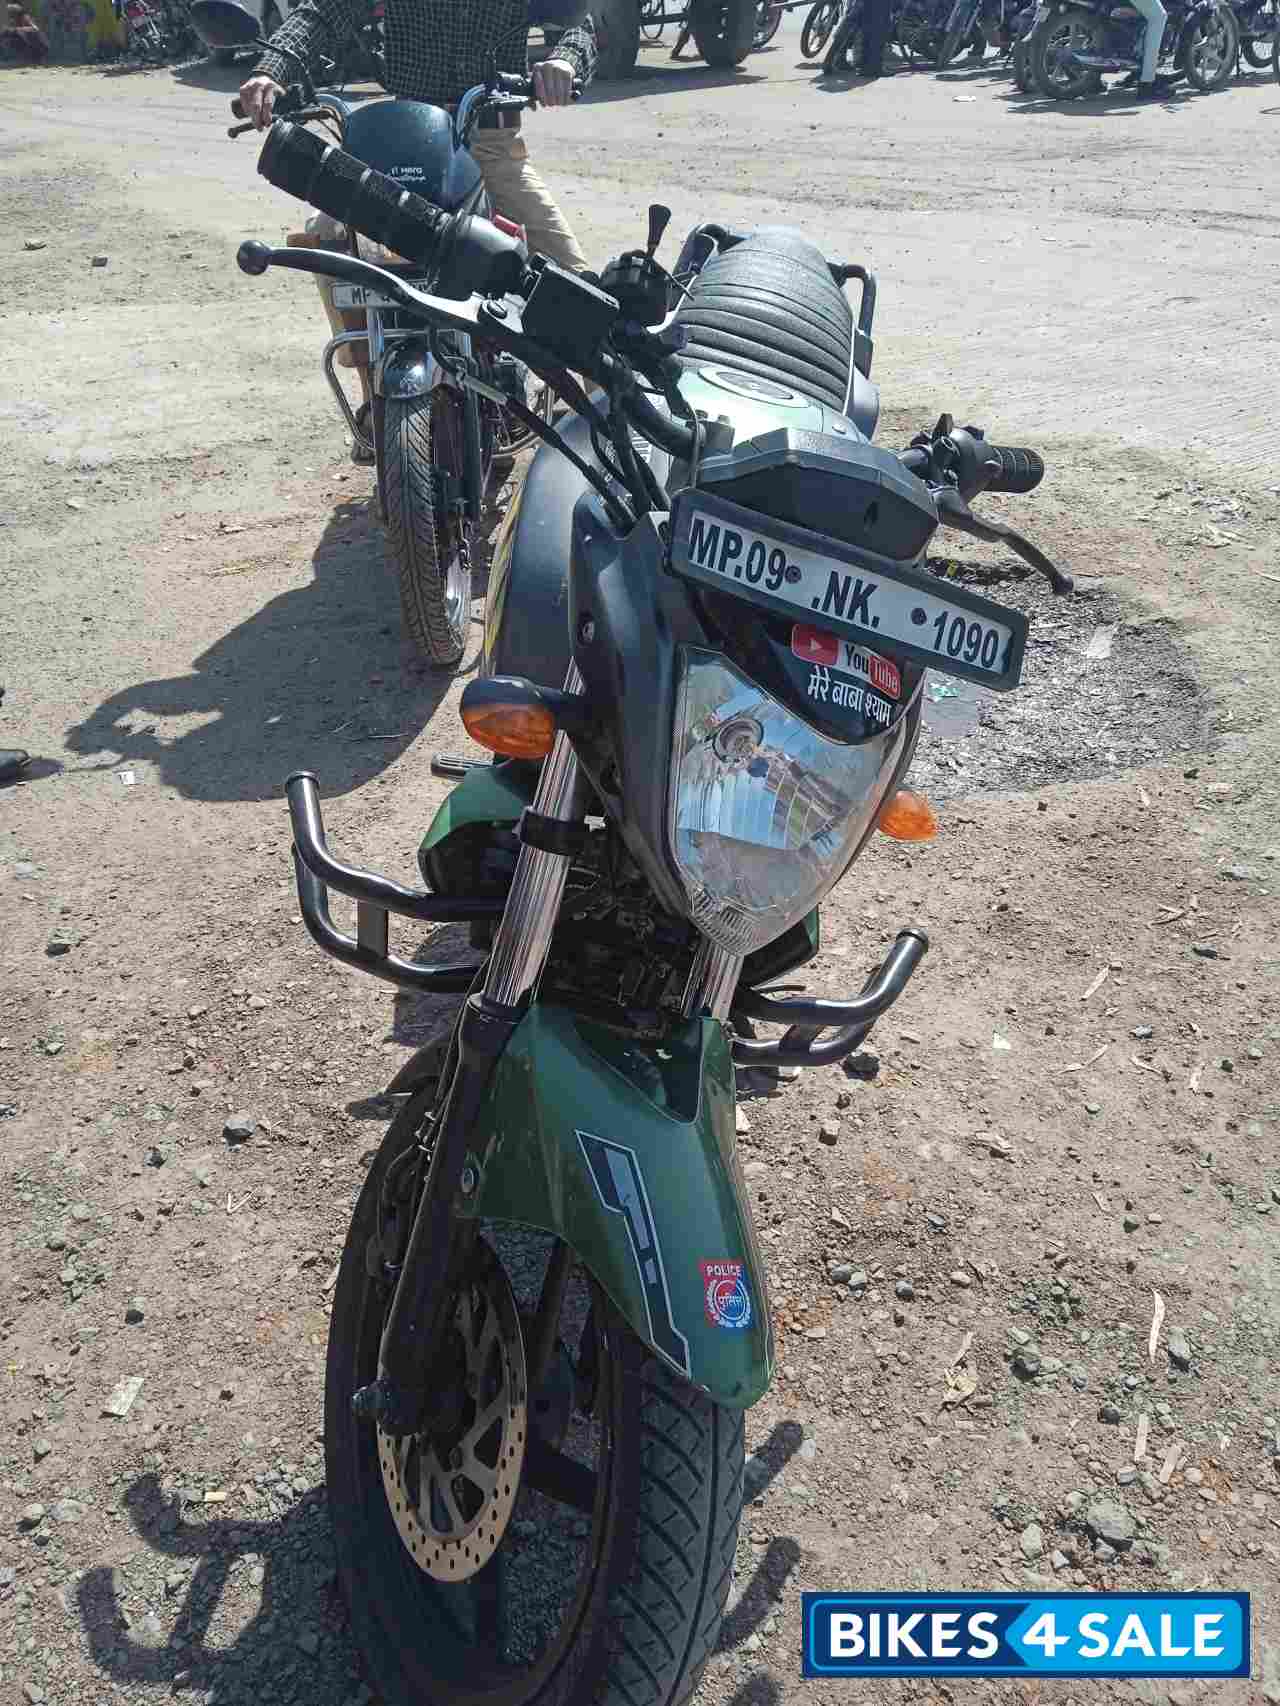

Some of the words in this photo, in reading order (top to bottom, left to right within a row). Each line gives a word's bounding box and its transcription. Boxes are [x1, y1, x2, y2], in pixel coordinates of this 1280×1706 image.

[688, 519, 786, 590] MP.09
[933, 611, 999, 668] 1090
[808, 664, 831, 702] मेरे
[832, 681, 864, 712] बाबा
[865, 692, 891, 726] श्याम
[707, 1265, 741, 1277] POLICE
